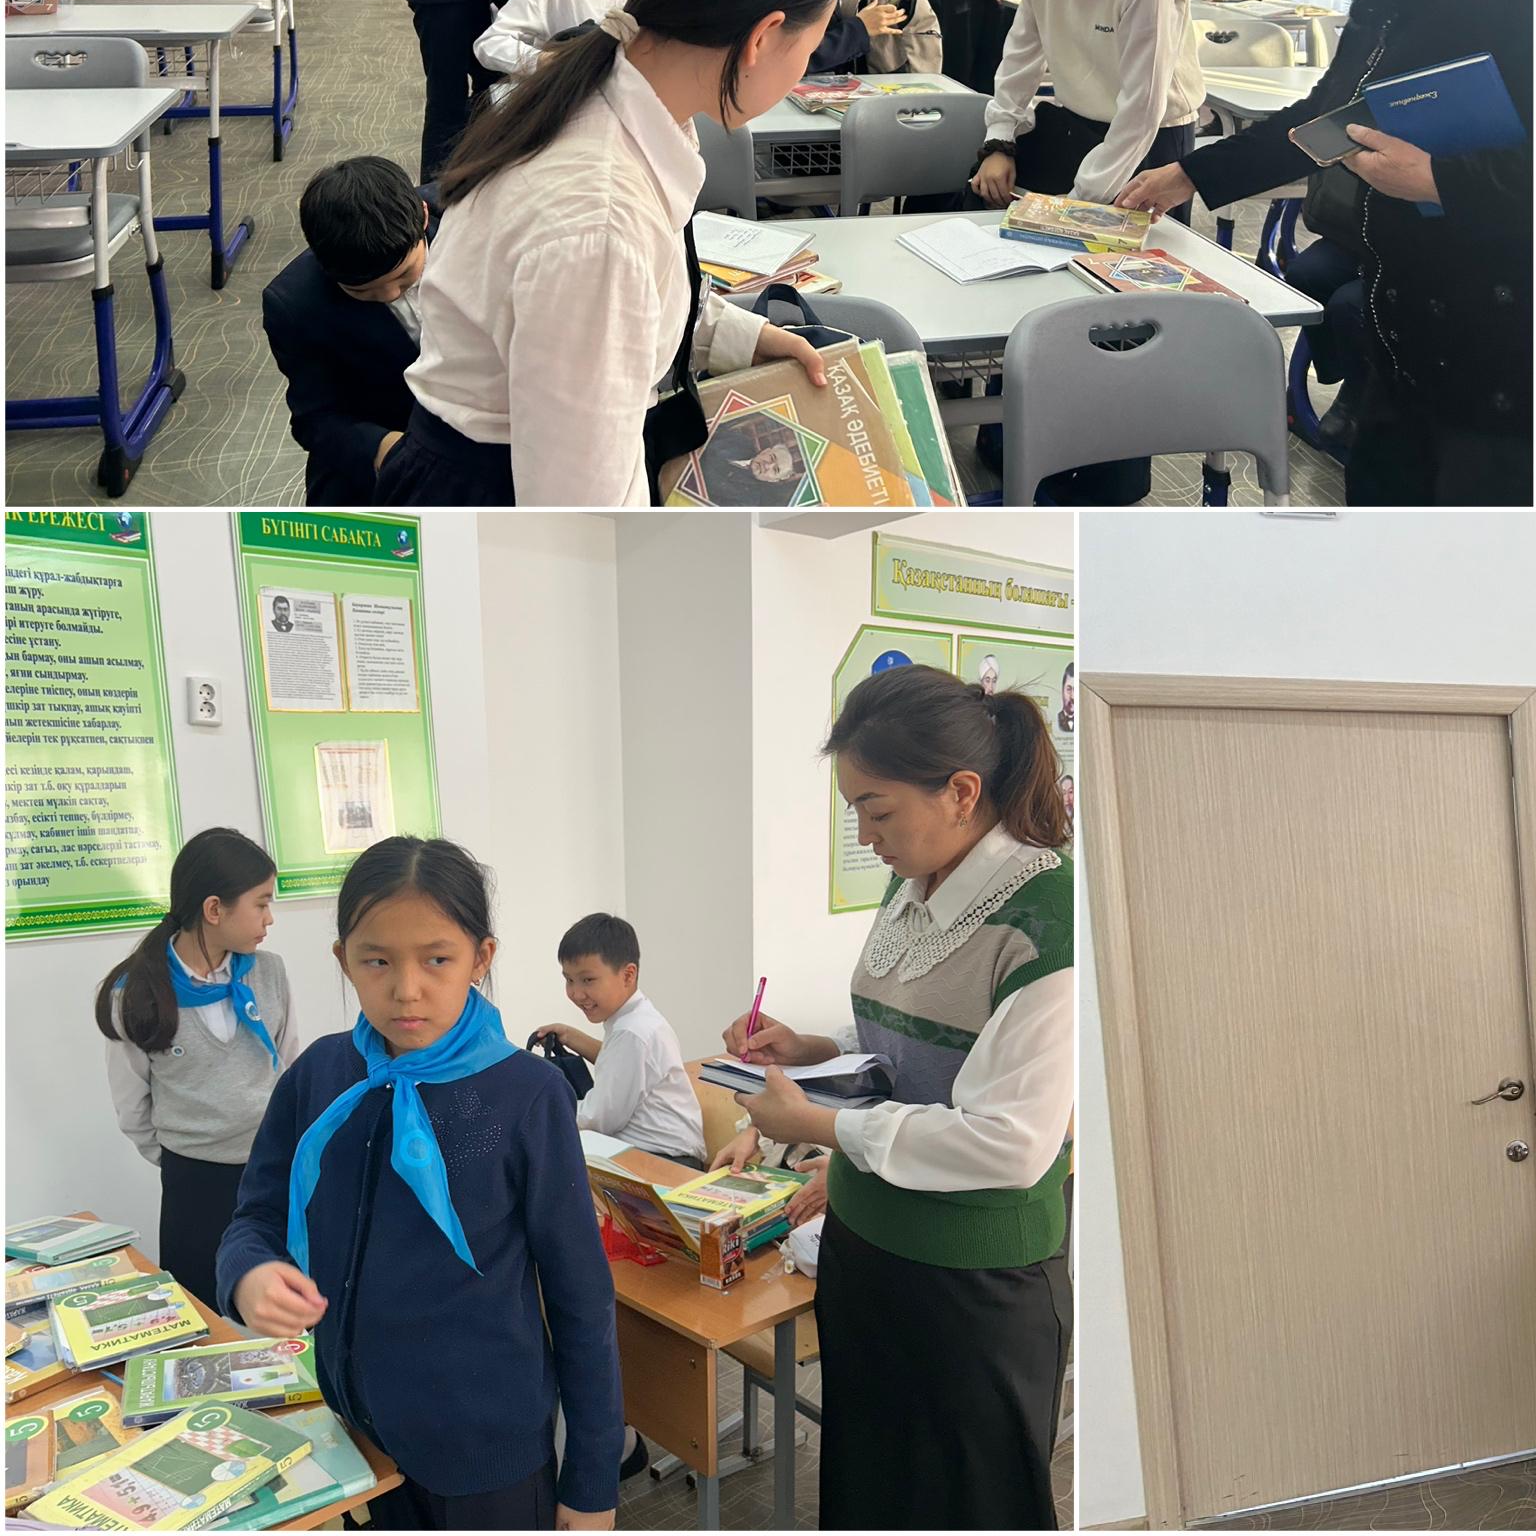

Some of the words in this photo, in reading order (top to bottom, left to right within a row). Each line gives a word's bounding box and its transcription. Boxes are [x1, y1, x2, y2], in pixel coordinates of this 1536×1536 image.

[261, 517, 318, 541] БҮГІНГІ
[321, 525, 382, 548] САБАҚТА
[89, 1318, 192, 1352] МАТЕМАТИКА
